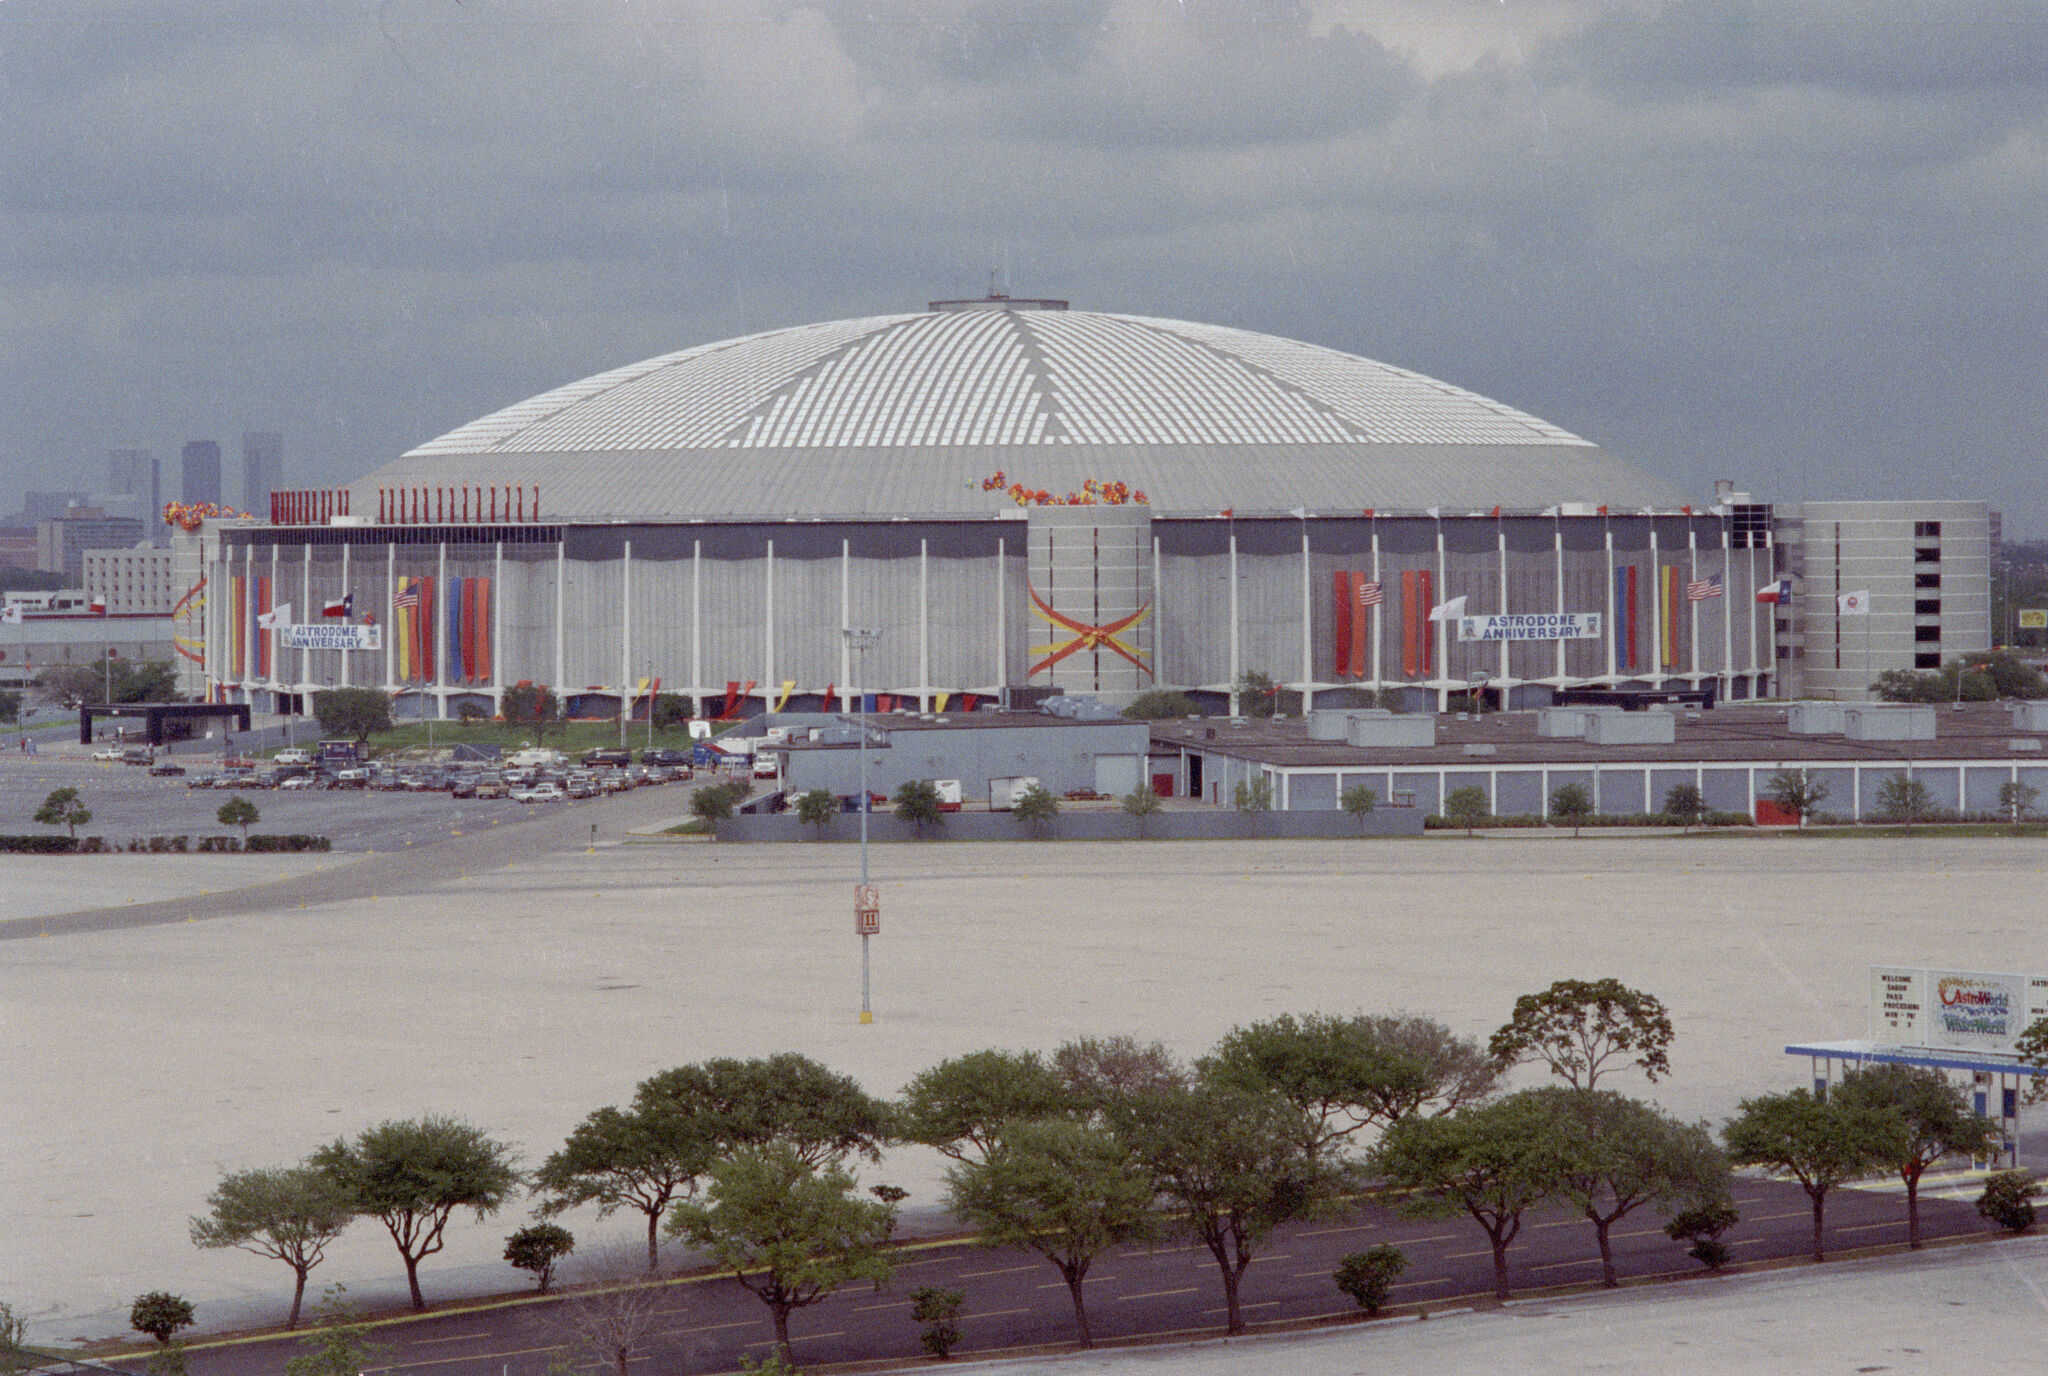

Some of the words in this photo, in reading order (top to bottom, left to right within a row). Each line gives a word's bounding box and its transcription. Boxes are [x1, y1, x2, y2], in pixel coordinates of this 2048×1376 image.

[1488, 615, 1576, 627] ASTRODOME
[295, 626, 357, 637] ASTRODOME
[1482, 627, 1581, 639] ANNIVERSARY
[291, 637, 363, 648] ANNIVERSARY
[865, 913, 876, 926] 11
[1881, 975, 1911, 983] WELCOME
[1940, 987, 2009, 1006] AstroWorld
[1883, 1002, 1920, 1010] PROCESSING
[1944, 1016, 2006, 1035] WaterWorld
